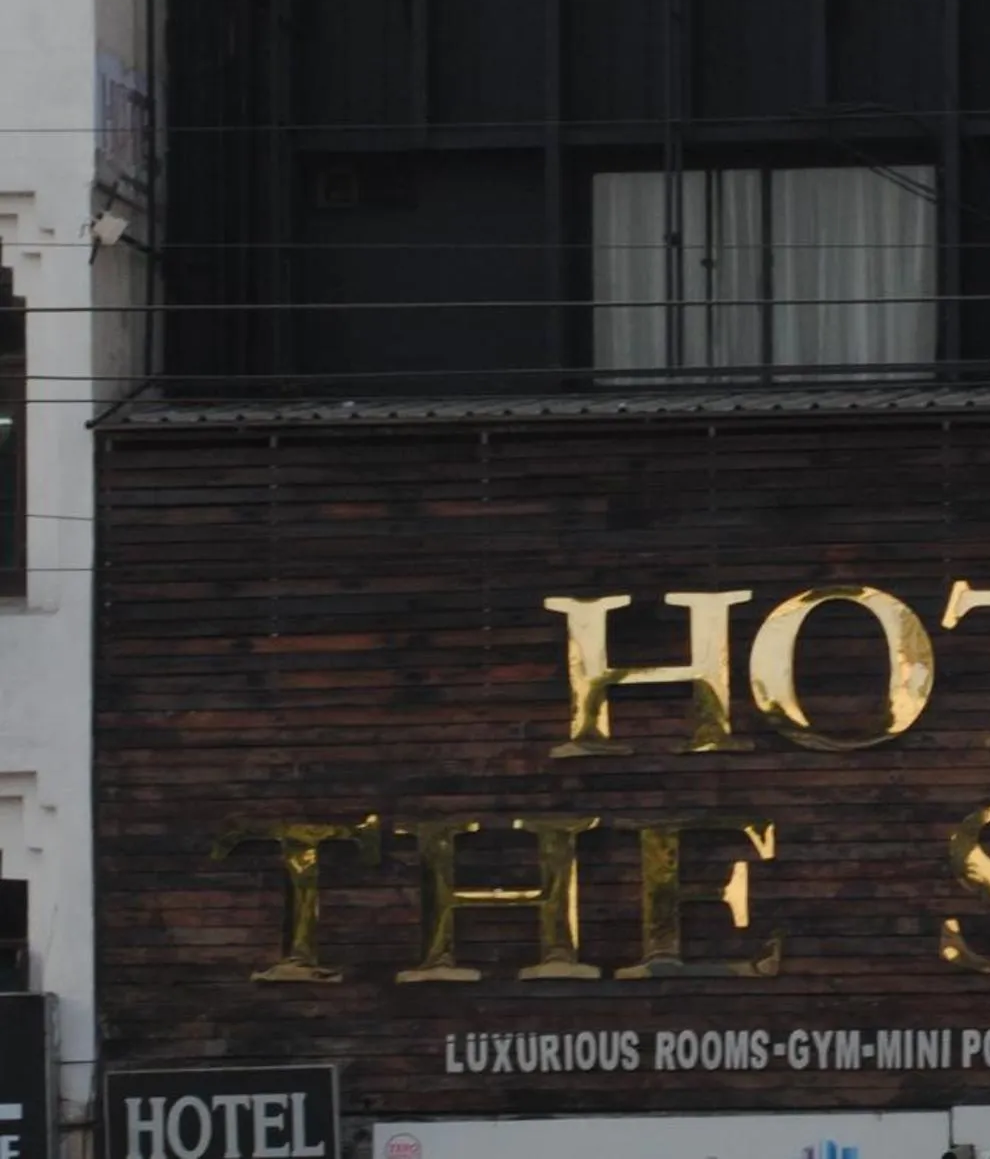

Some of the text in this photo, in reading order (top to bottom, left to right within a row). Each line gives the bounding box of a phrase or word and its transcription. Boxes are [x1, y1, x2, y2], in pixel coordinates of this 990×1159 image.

[211, 814, 782, 983] THE
[445, 1030, 640, 1073] LUXURIOUS
[124, 1093, 325, 1159] HOTEL
